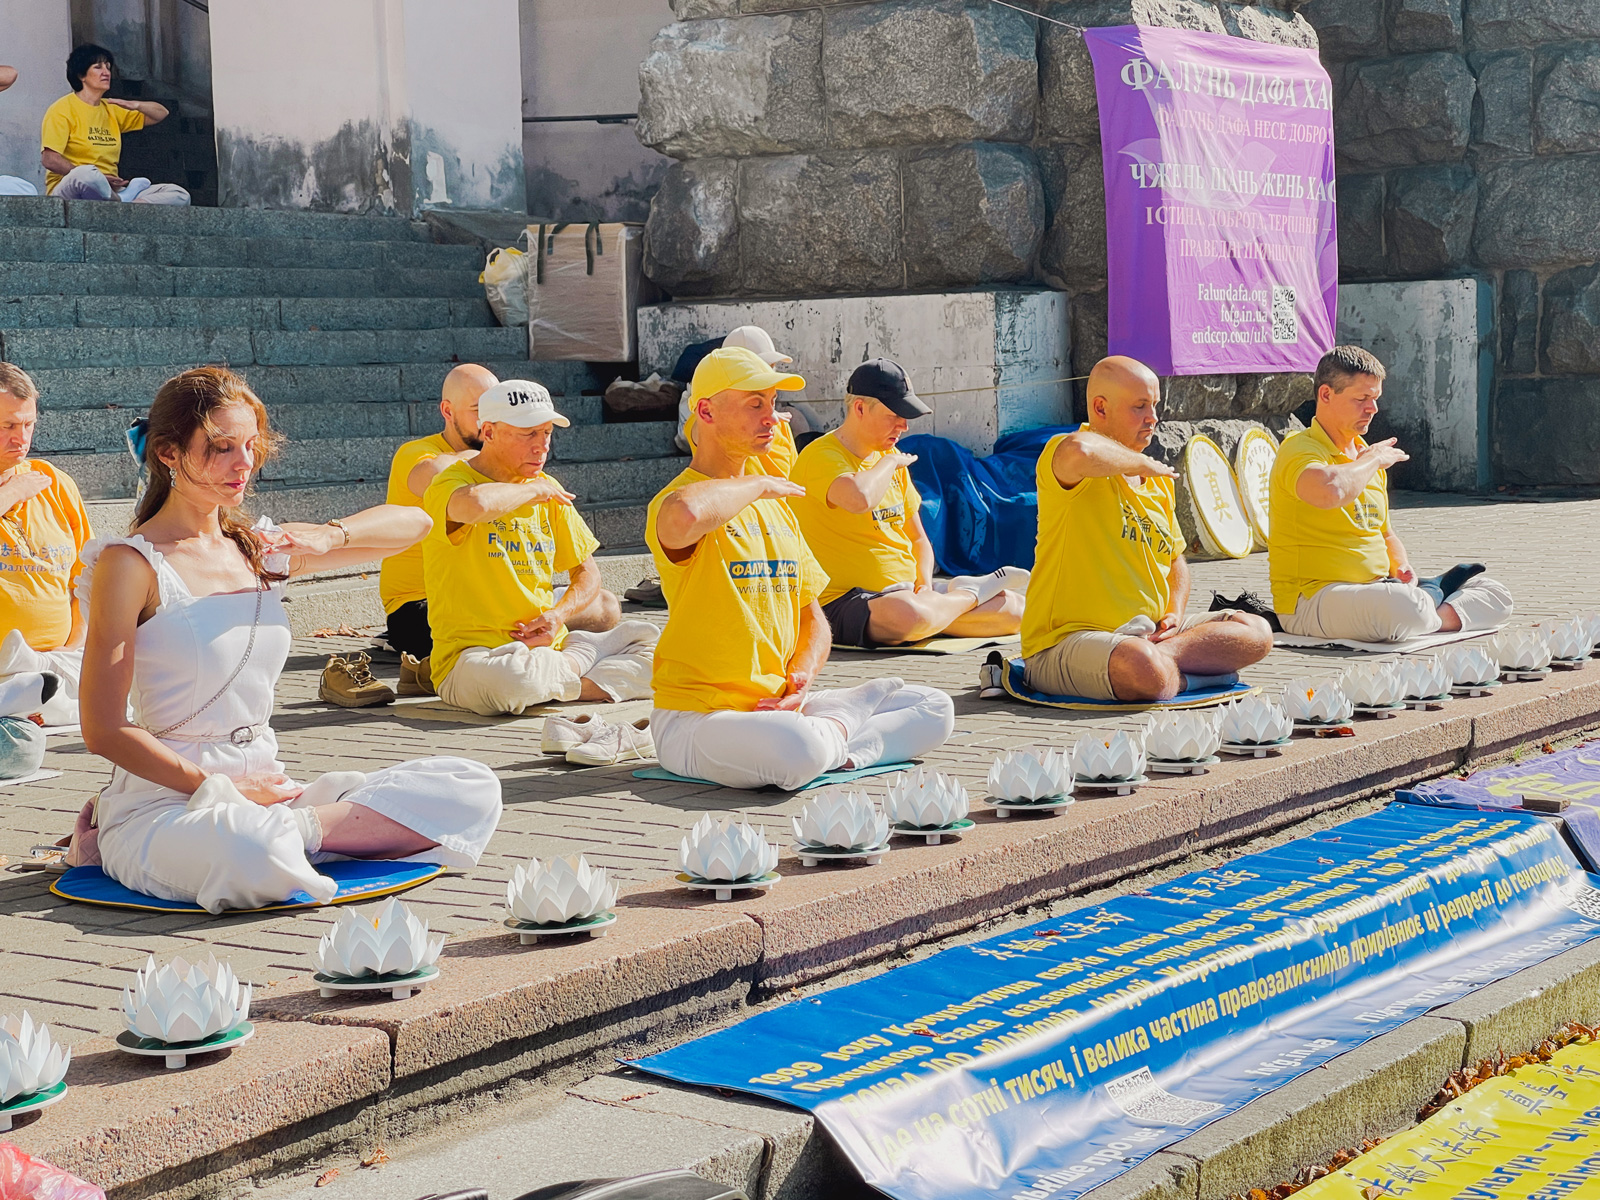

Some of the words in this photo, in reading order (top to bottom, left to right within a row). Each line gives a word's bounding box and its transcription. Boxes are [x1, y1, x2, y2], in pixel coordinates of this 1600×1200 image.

[1121, 58, 1236, 99] ФАЛУНЬ
[1240, 71, 1298, 110] ДАФА
[1302, 78, 1333, 110] ХА
[1217, 113, 1251, 137] ДАФА
[1254, 119, 1287, 140] НЕСЕ
[1129, 163, 1205, 190] ЧЖЕНЬ
[1210, 166, 1258, 194] ШАНЬ
[1262, 173, 1304, 199] ЖЕНЬ
[1198, 283, 1267, 306] Falundafa.org
[1221, 304, 1268, 326] fofg.in.ua
[1192, 326, 1268, 348] endccp.com/uk
[749, 1061, 823, 1085] 1999
[821, 1033, 893, 1061] року
[1097, 933, 1170, 957] Китаю
[1163, 909, 1235, 936] почала
[914, 1112, 947, 1144] на
[948, 1078, 1009, 1128] сотні
[1004, 1059, 1076, 1104] тисяч,
[1069, 1045, 1084, 1078] і
[1082, 1025, 1150, 1073] велика
[1149, 1000, 1217, 1043] частина
[1218, 942, 1349, 1019] правозахисників
[1351, 914, 1425, 964] прирівнює
[1423, 902, 1440, 932] ці
[1438, 879, 1496, 929] репресії
[1494, 881, 1512, 905] до
[791, 1045, 934, 1092] Причиною
[932, 1018, 1004, 1044] стала
[1002, 965, 1141, 1017] надзвичайна
[918, 1052, 976, 1076] 100
[1083, 1141, 1133, 1165] про
